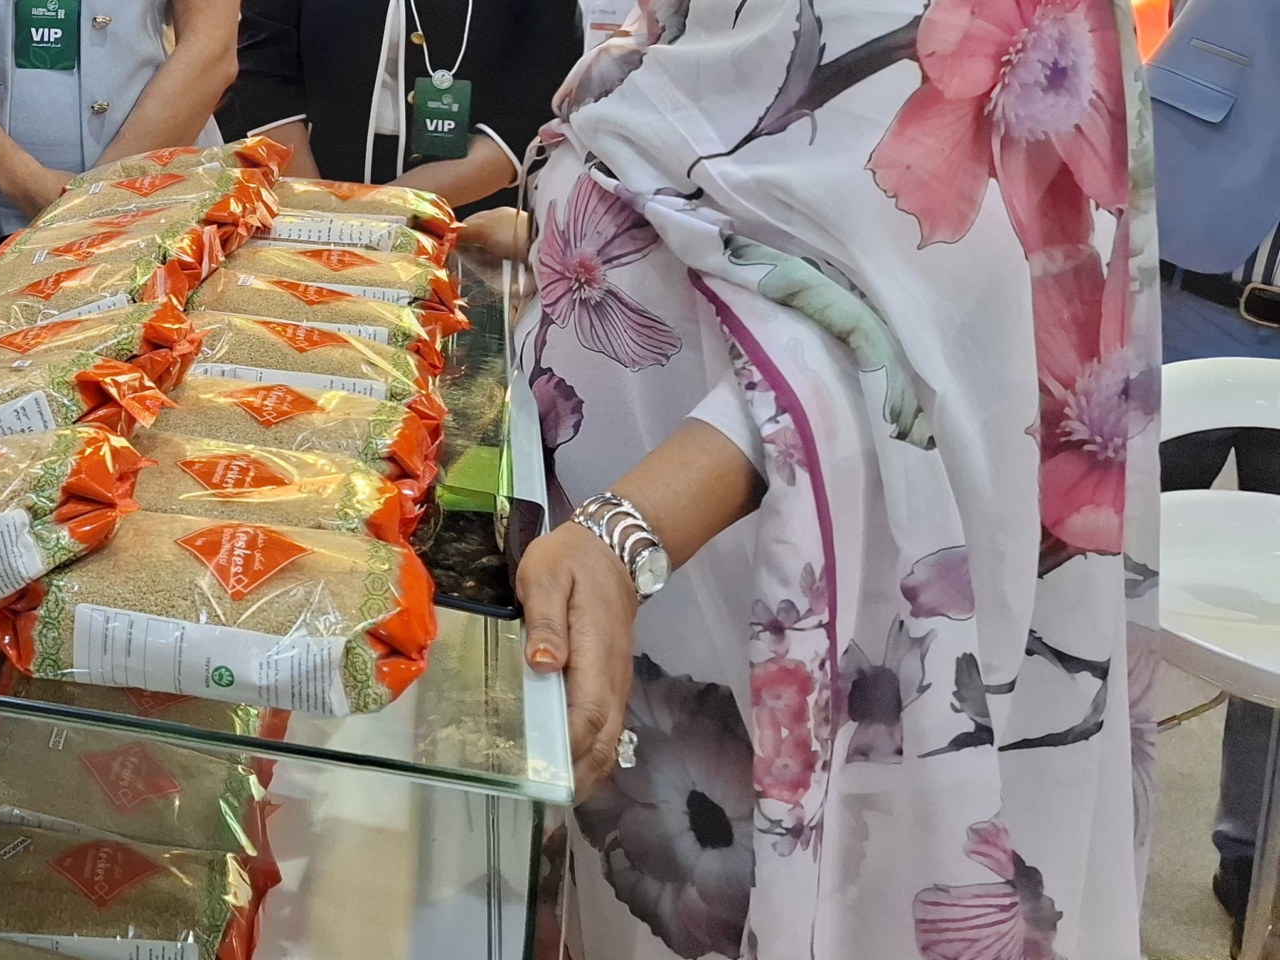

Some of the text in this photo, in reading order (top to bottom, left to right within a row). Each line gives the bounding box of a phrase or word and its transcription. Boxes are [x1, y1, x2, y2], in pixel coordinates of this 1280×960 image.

[30, 27, 63, 42] VIP
[425, 118, 456, 132] VIP
[222, 460, 247, 490] Keskes
[232, 526, 254, 573] Keskes
